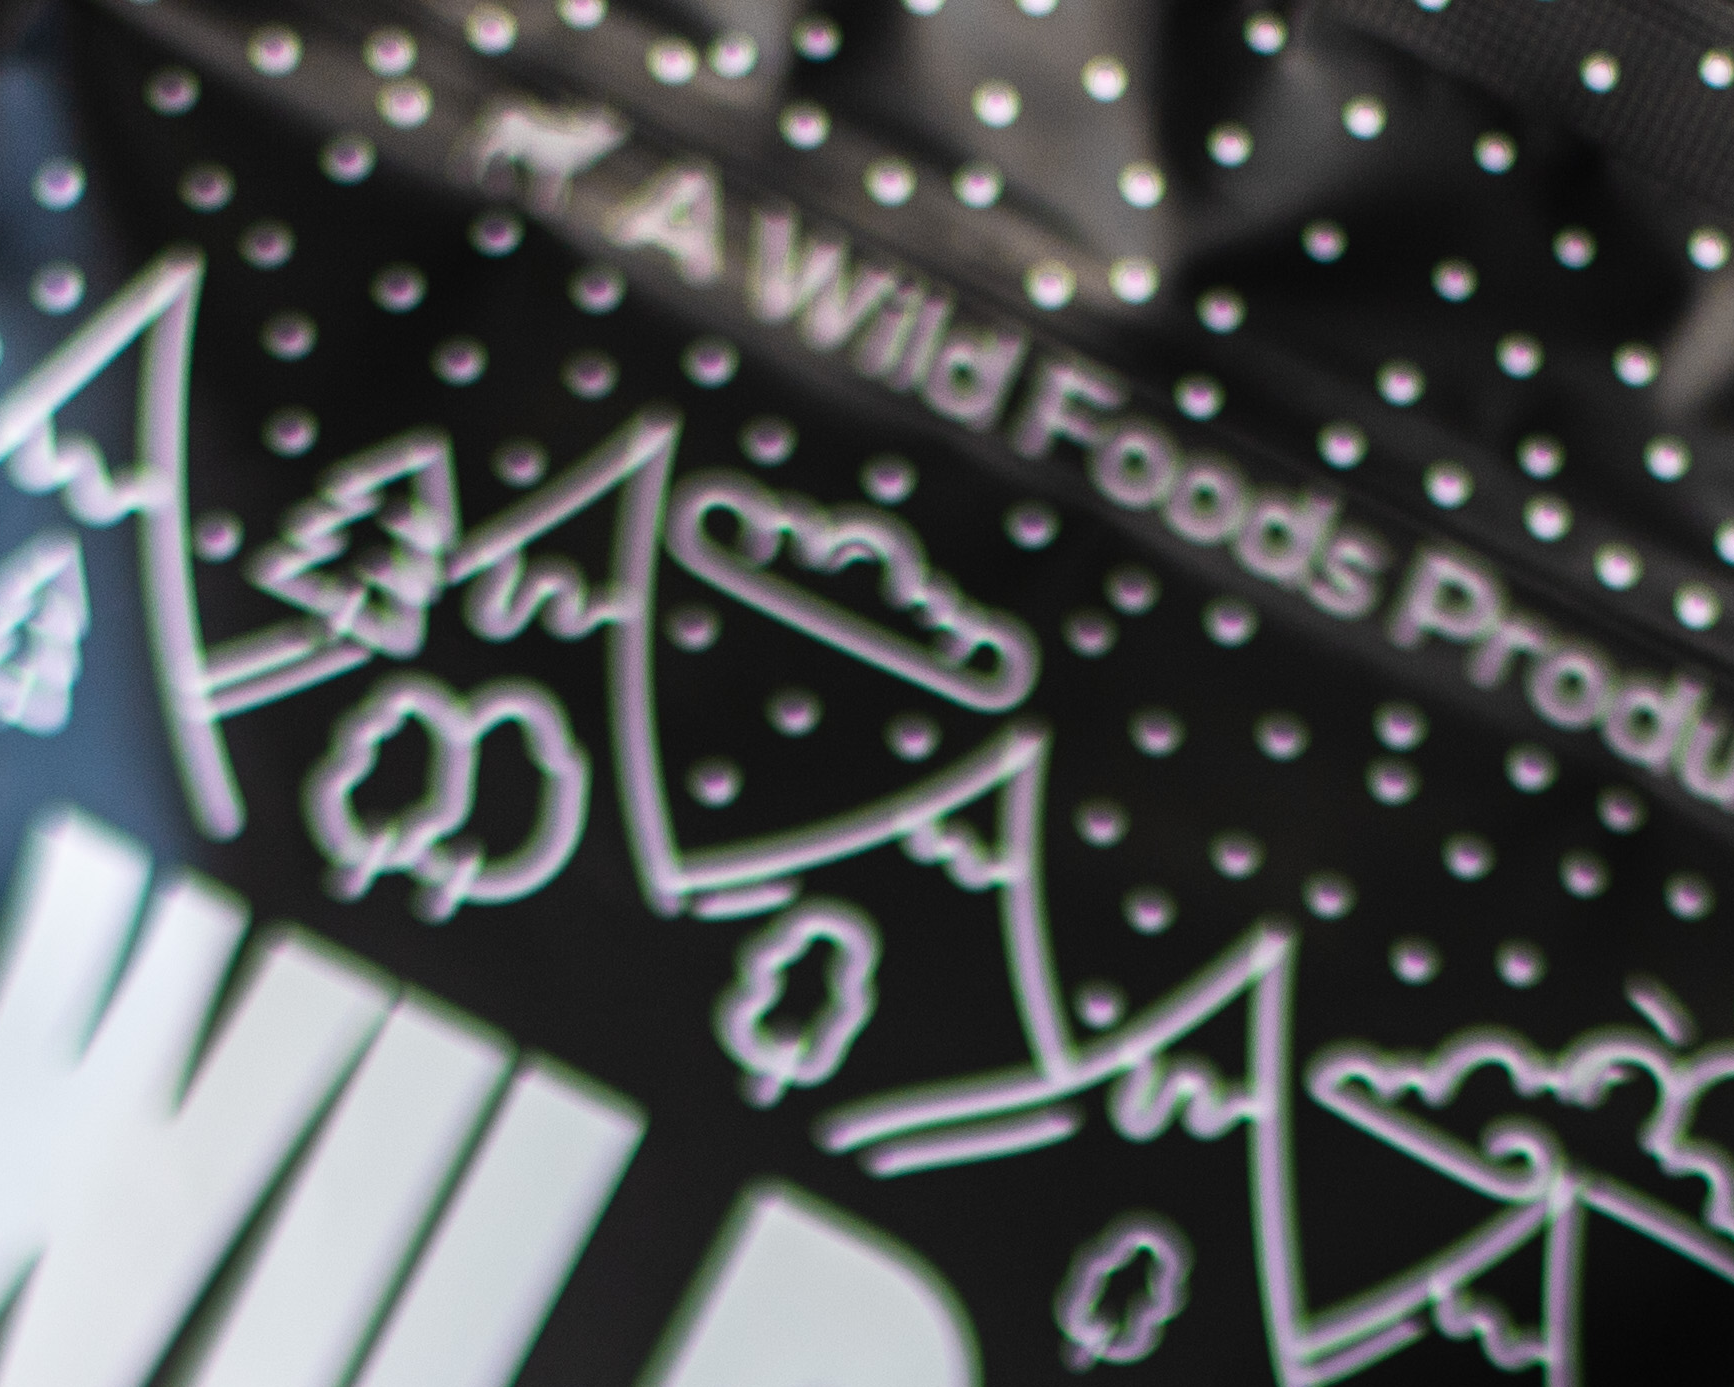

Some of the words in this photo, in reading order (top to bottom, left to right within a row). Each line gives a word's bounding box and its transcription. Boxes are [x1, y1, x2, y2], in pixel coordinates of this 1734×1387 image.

[613, 157, 726, 286] A
[747, 206, 1028, 436] Wild
[1010, 359, 1392, 622] Foods
